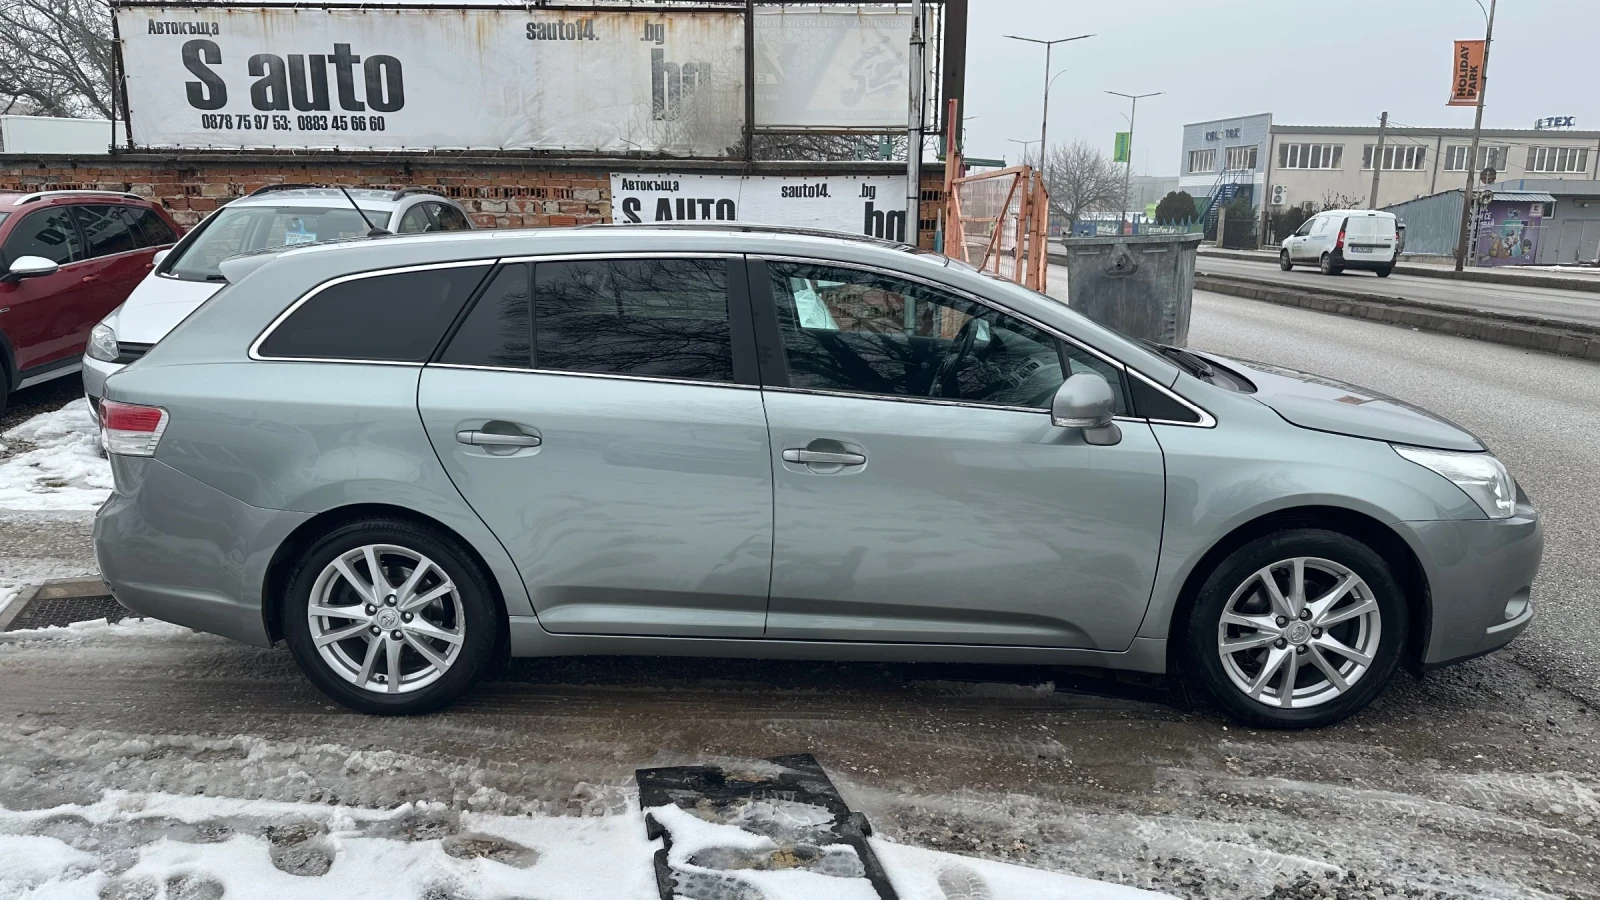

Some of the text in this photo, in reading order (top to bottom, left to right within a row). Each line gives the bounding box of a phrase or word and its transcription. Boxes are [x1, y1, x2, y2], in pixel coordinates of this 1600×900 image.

[148, 19, 219, 37] Автокъща
[526, 19, 665, 45] sauto14. .bg
[181, 39, 405, 112] S auto
[1457, 44, 1479, 97] HOLIDAY PARK
[202, 113, 386, 131] 0878 75 97 53; 0883 45 66 60
[1544, 116, 1576, 126] TEX
[621, 178, 680, 192] Автокъща
[781, 183, 876, 200] sauto14. .bg
[622, 197, 643, 223] S
